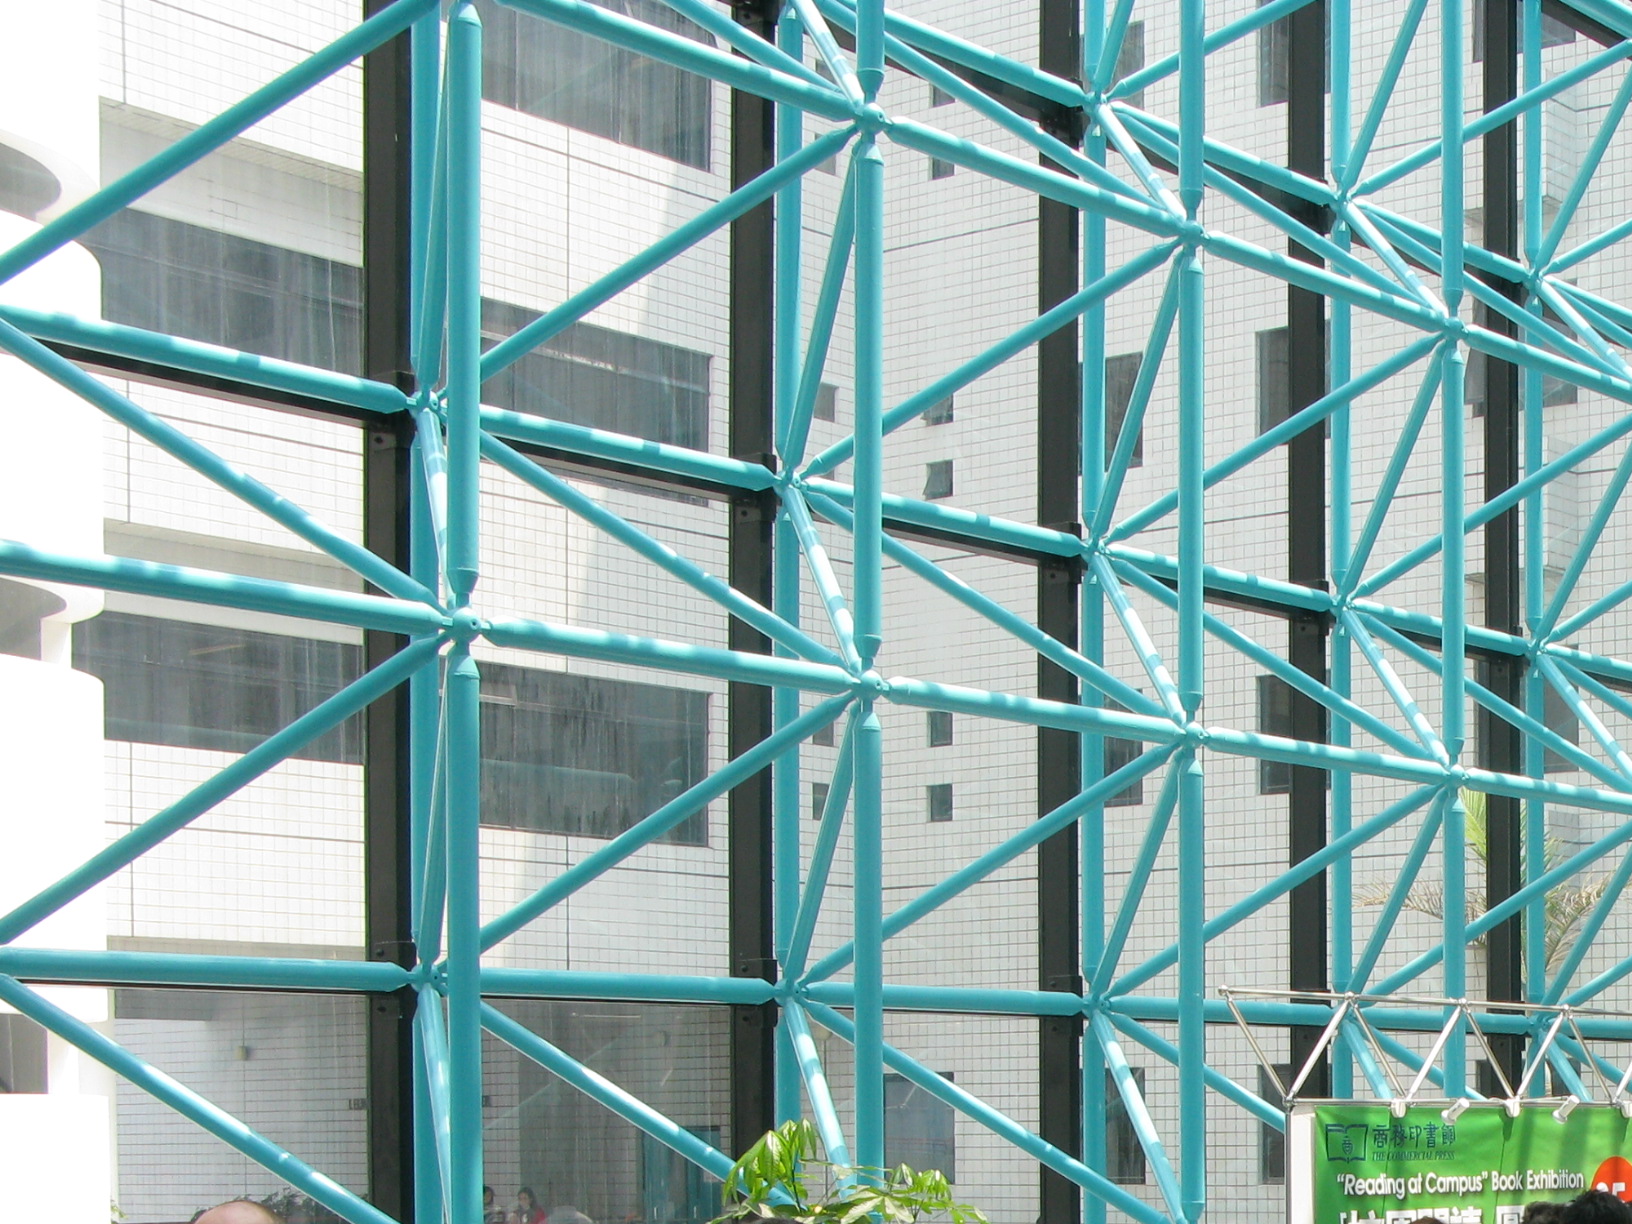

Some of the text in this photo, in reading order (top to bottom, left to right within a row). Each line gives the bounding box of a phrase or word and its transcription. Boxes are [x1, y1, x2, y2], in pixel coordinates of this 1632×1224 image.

[1408, 1175, 1422, 1194] at
[1491, 1171, 1523, 1191] Book
[1526, 1169, 1584, 1191] Exhibition
